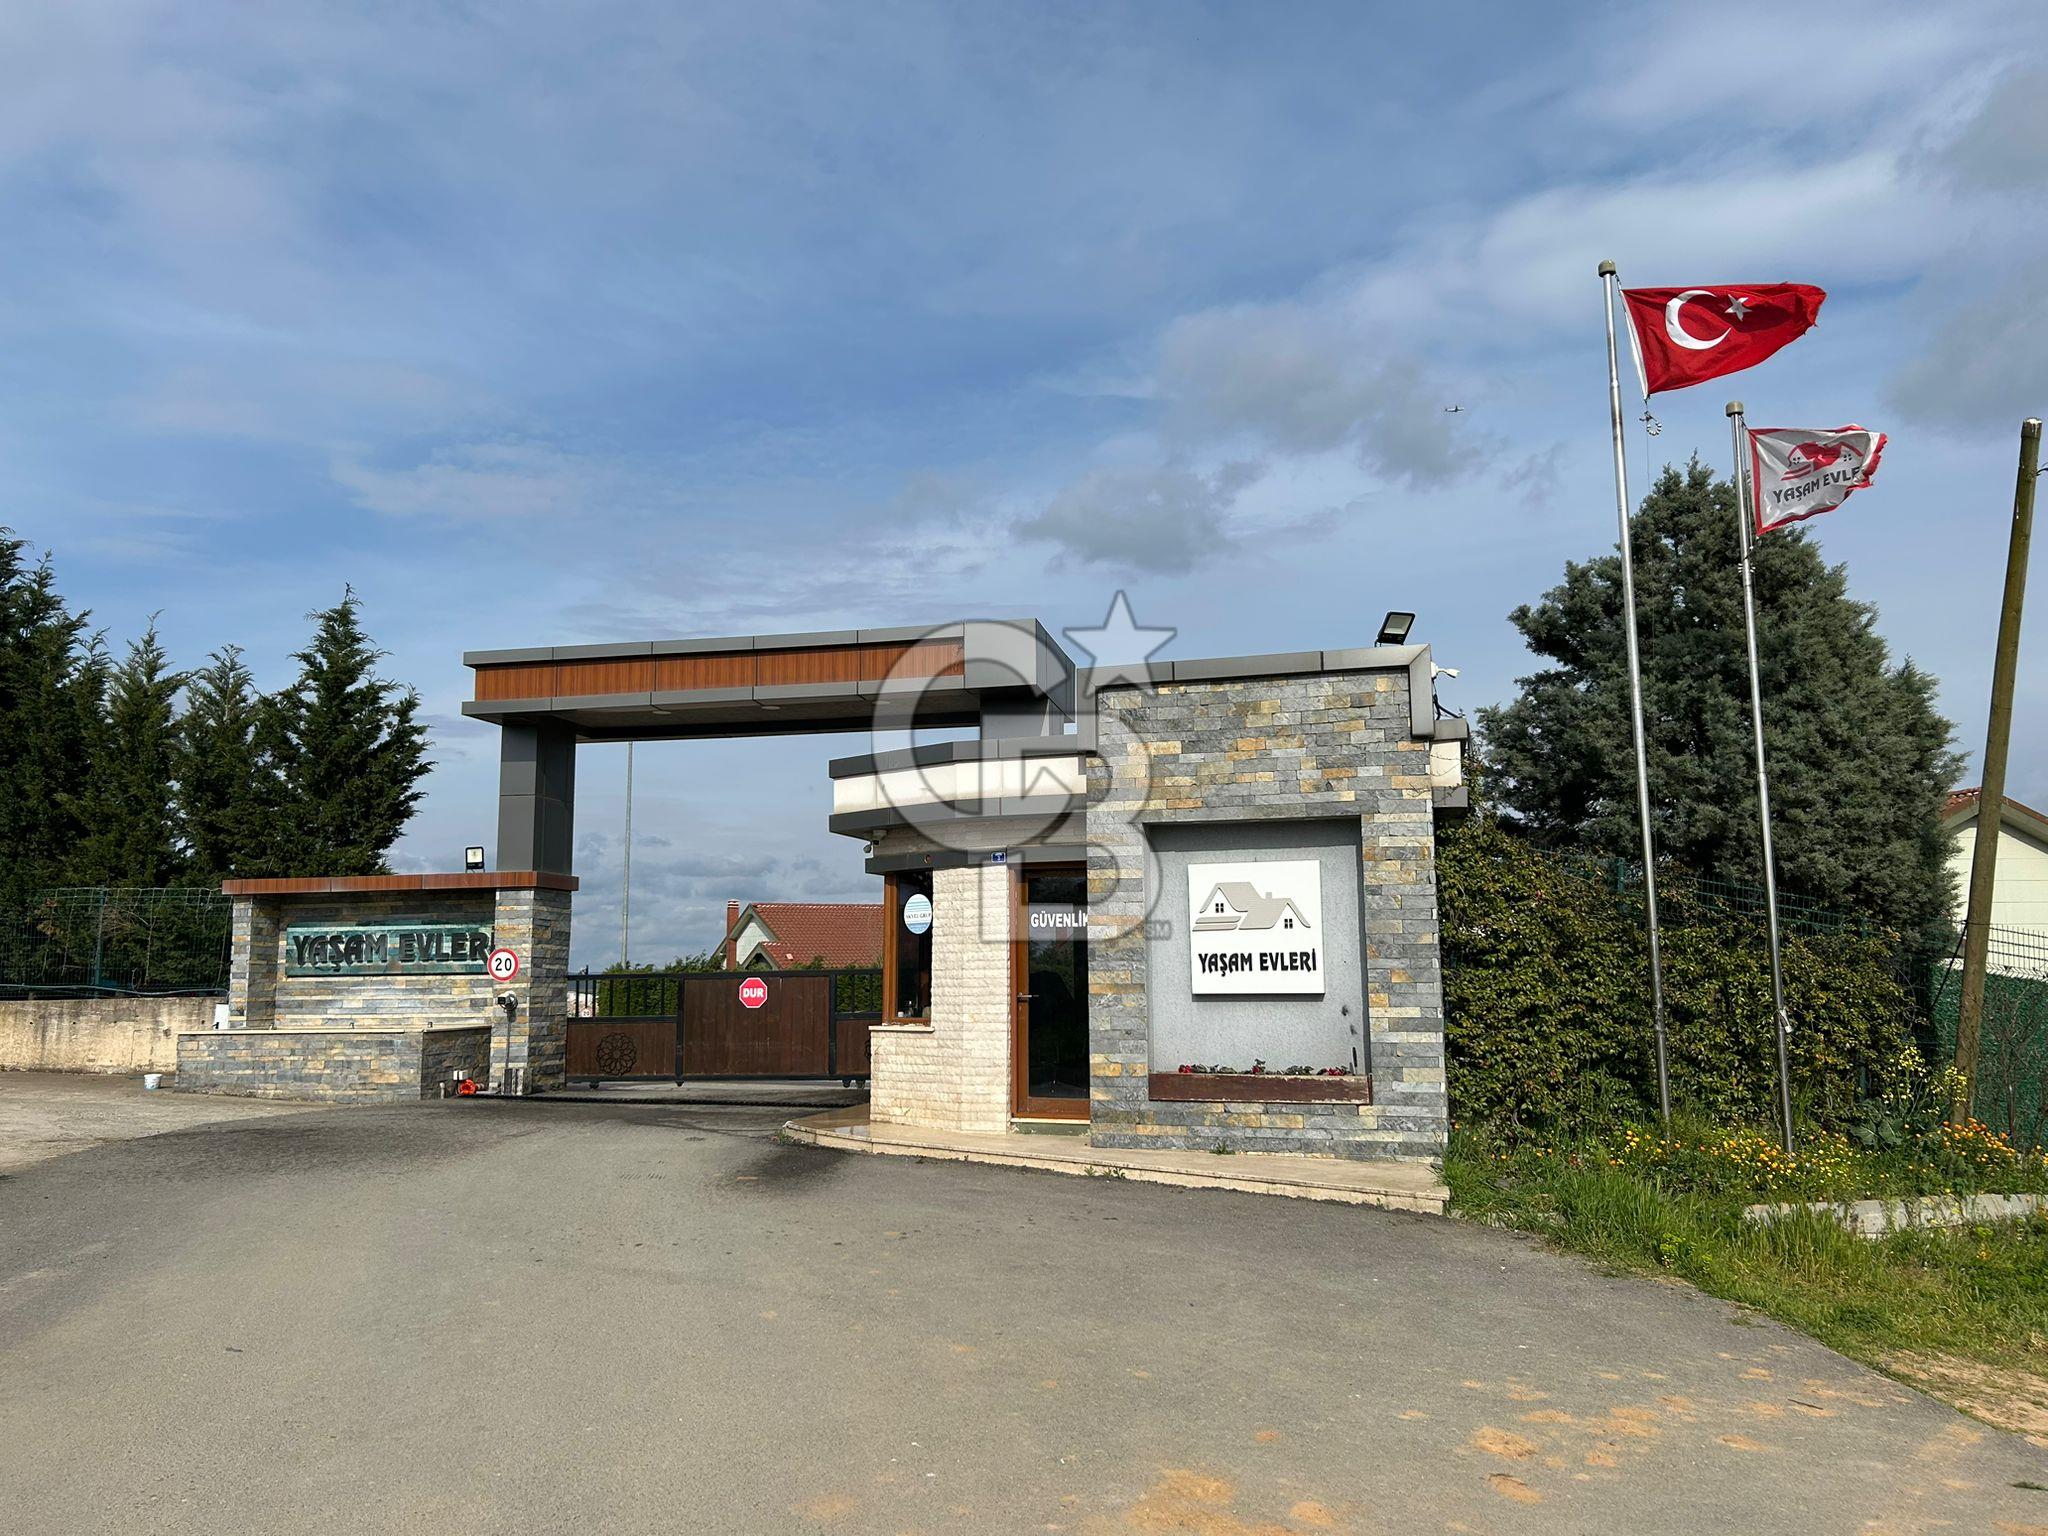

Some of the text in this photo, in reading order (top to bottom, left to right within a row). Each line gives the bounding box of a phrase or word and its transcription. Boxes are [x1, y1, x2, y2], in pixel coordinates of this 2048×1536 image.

[1772, 464, 1863, 503] YAŞAM EVLE
[293, 933, 389, 972] YAŞAM
[495, 957, 512, 971] 20
[1198, 948, 1317, 977] YAŞAM EVLERİ
[743, 987, 764, 998] DUR
